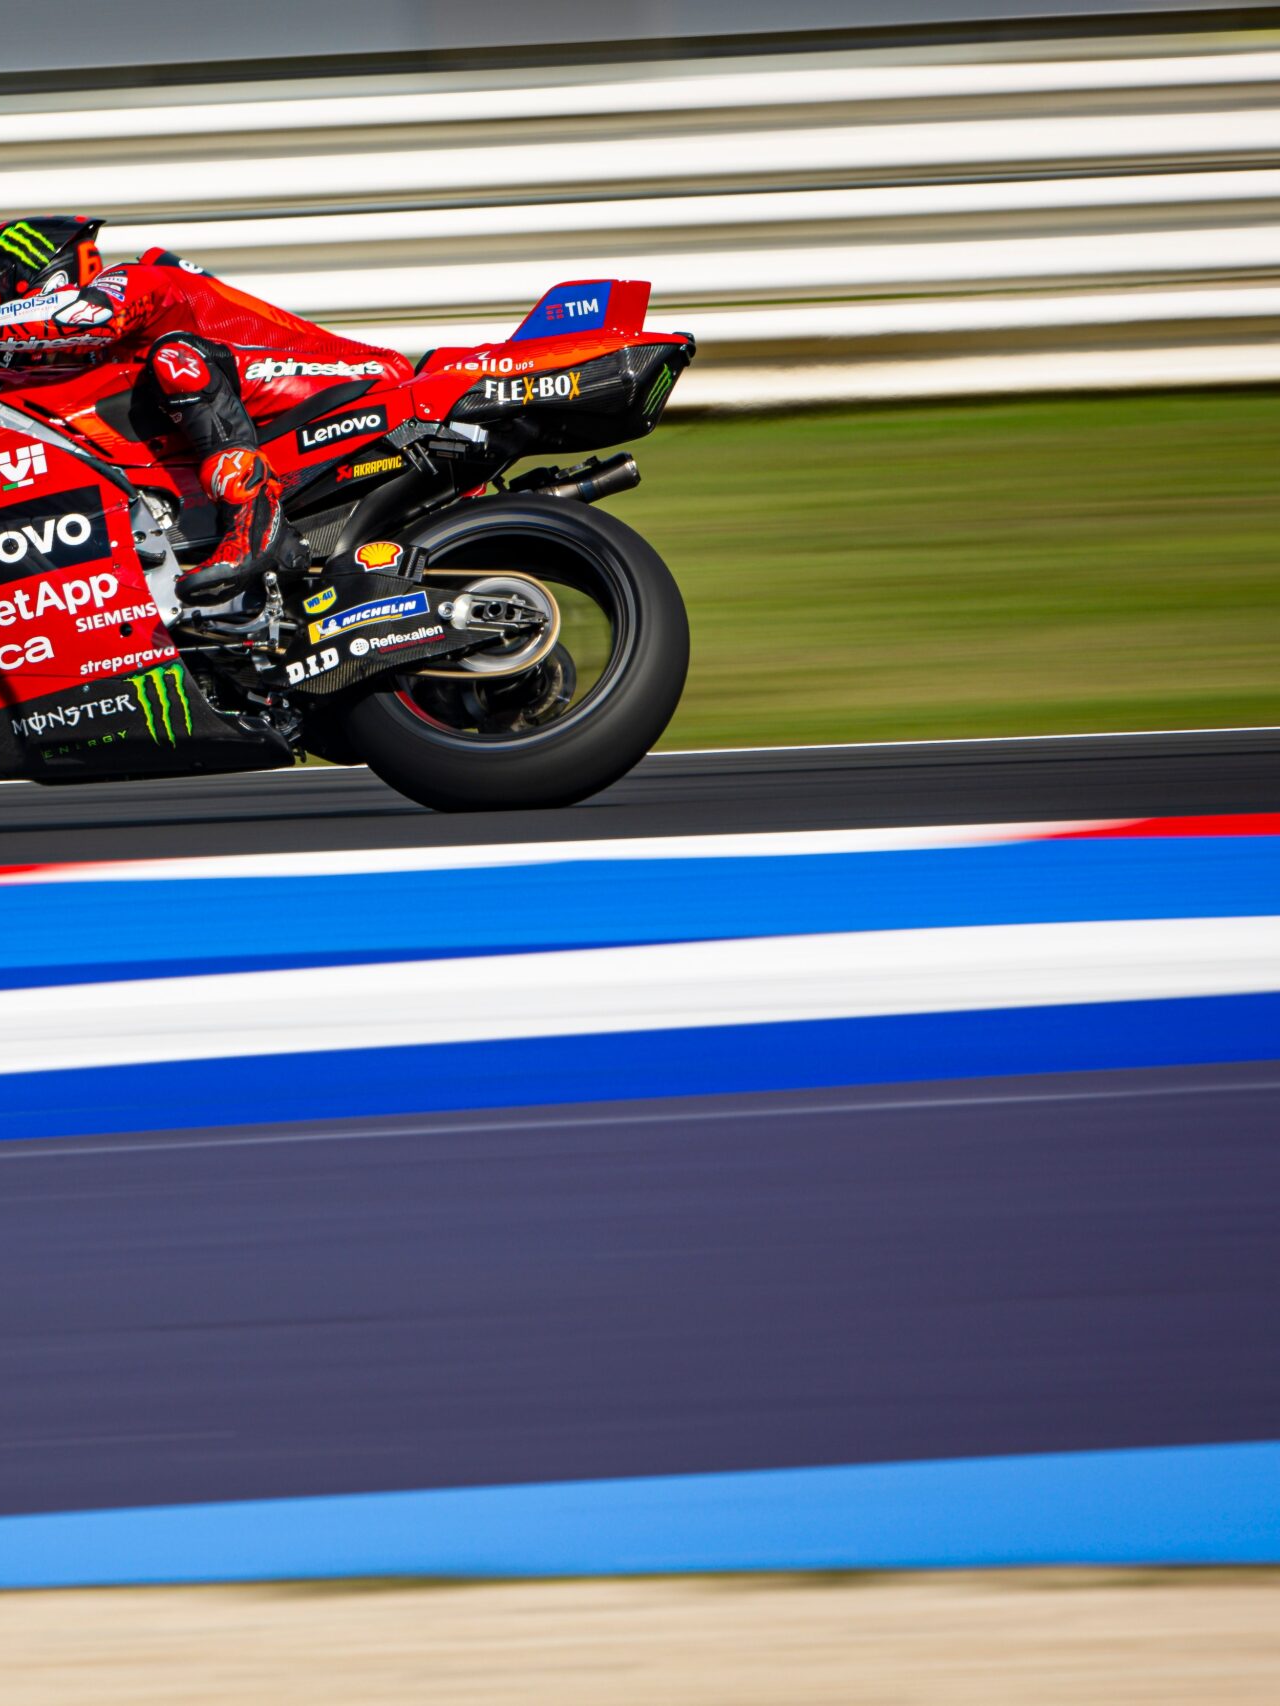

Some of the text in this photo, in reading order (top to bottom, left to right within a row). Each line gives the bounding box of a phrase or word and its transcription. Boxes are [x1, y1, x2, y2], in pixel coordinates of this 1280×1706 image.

[565, 298, 599, 317] TIM
[245, 358, 384, 382] alpinestars
[515, 360, 534, 371] ups
[484, 371, 581, 405] FLEX-BOX
[302, 414, 381, 447] Lenovo
[306, 590, 332, 608] WD-40
[75, 602, 158, 633] SIEMENS
[342, 600, 417, 626] MICHELIN
[369, 625, 444, 649] Reflexallen
[80, 646, 176, 675] streparava
[285, 647, 340, 685] D.I.D
[11, 693, 136, 737] MONSTER
